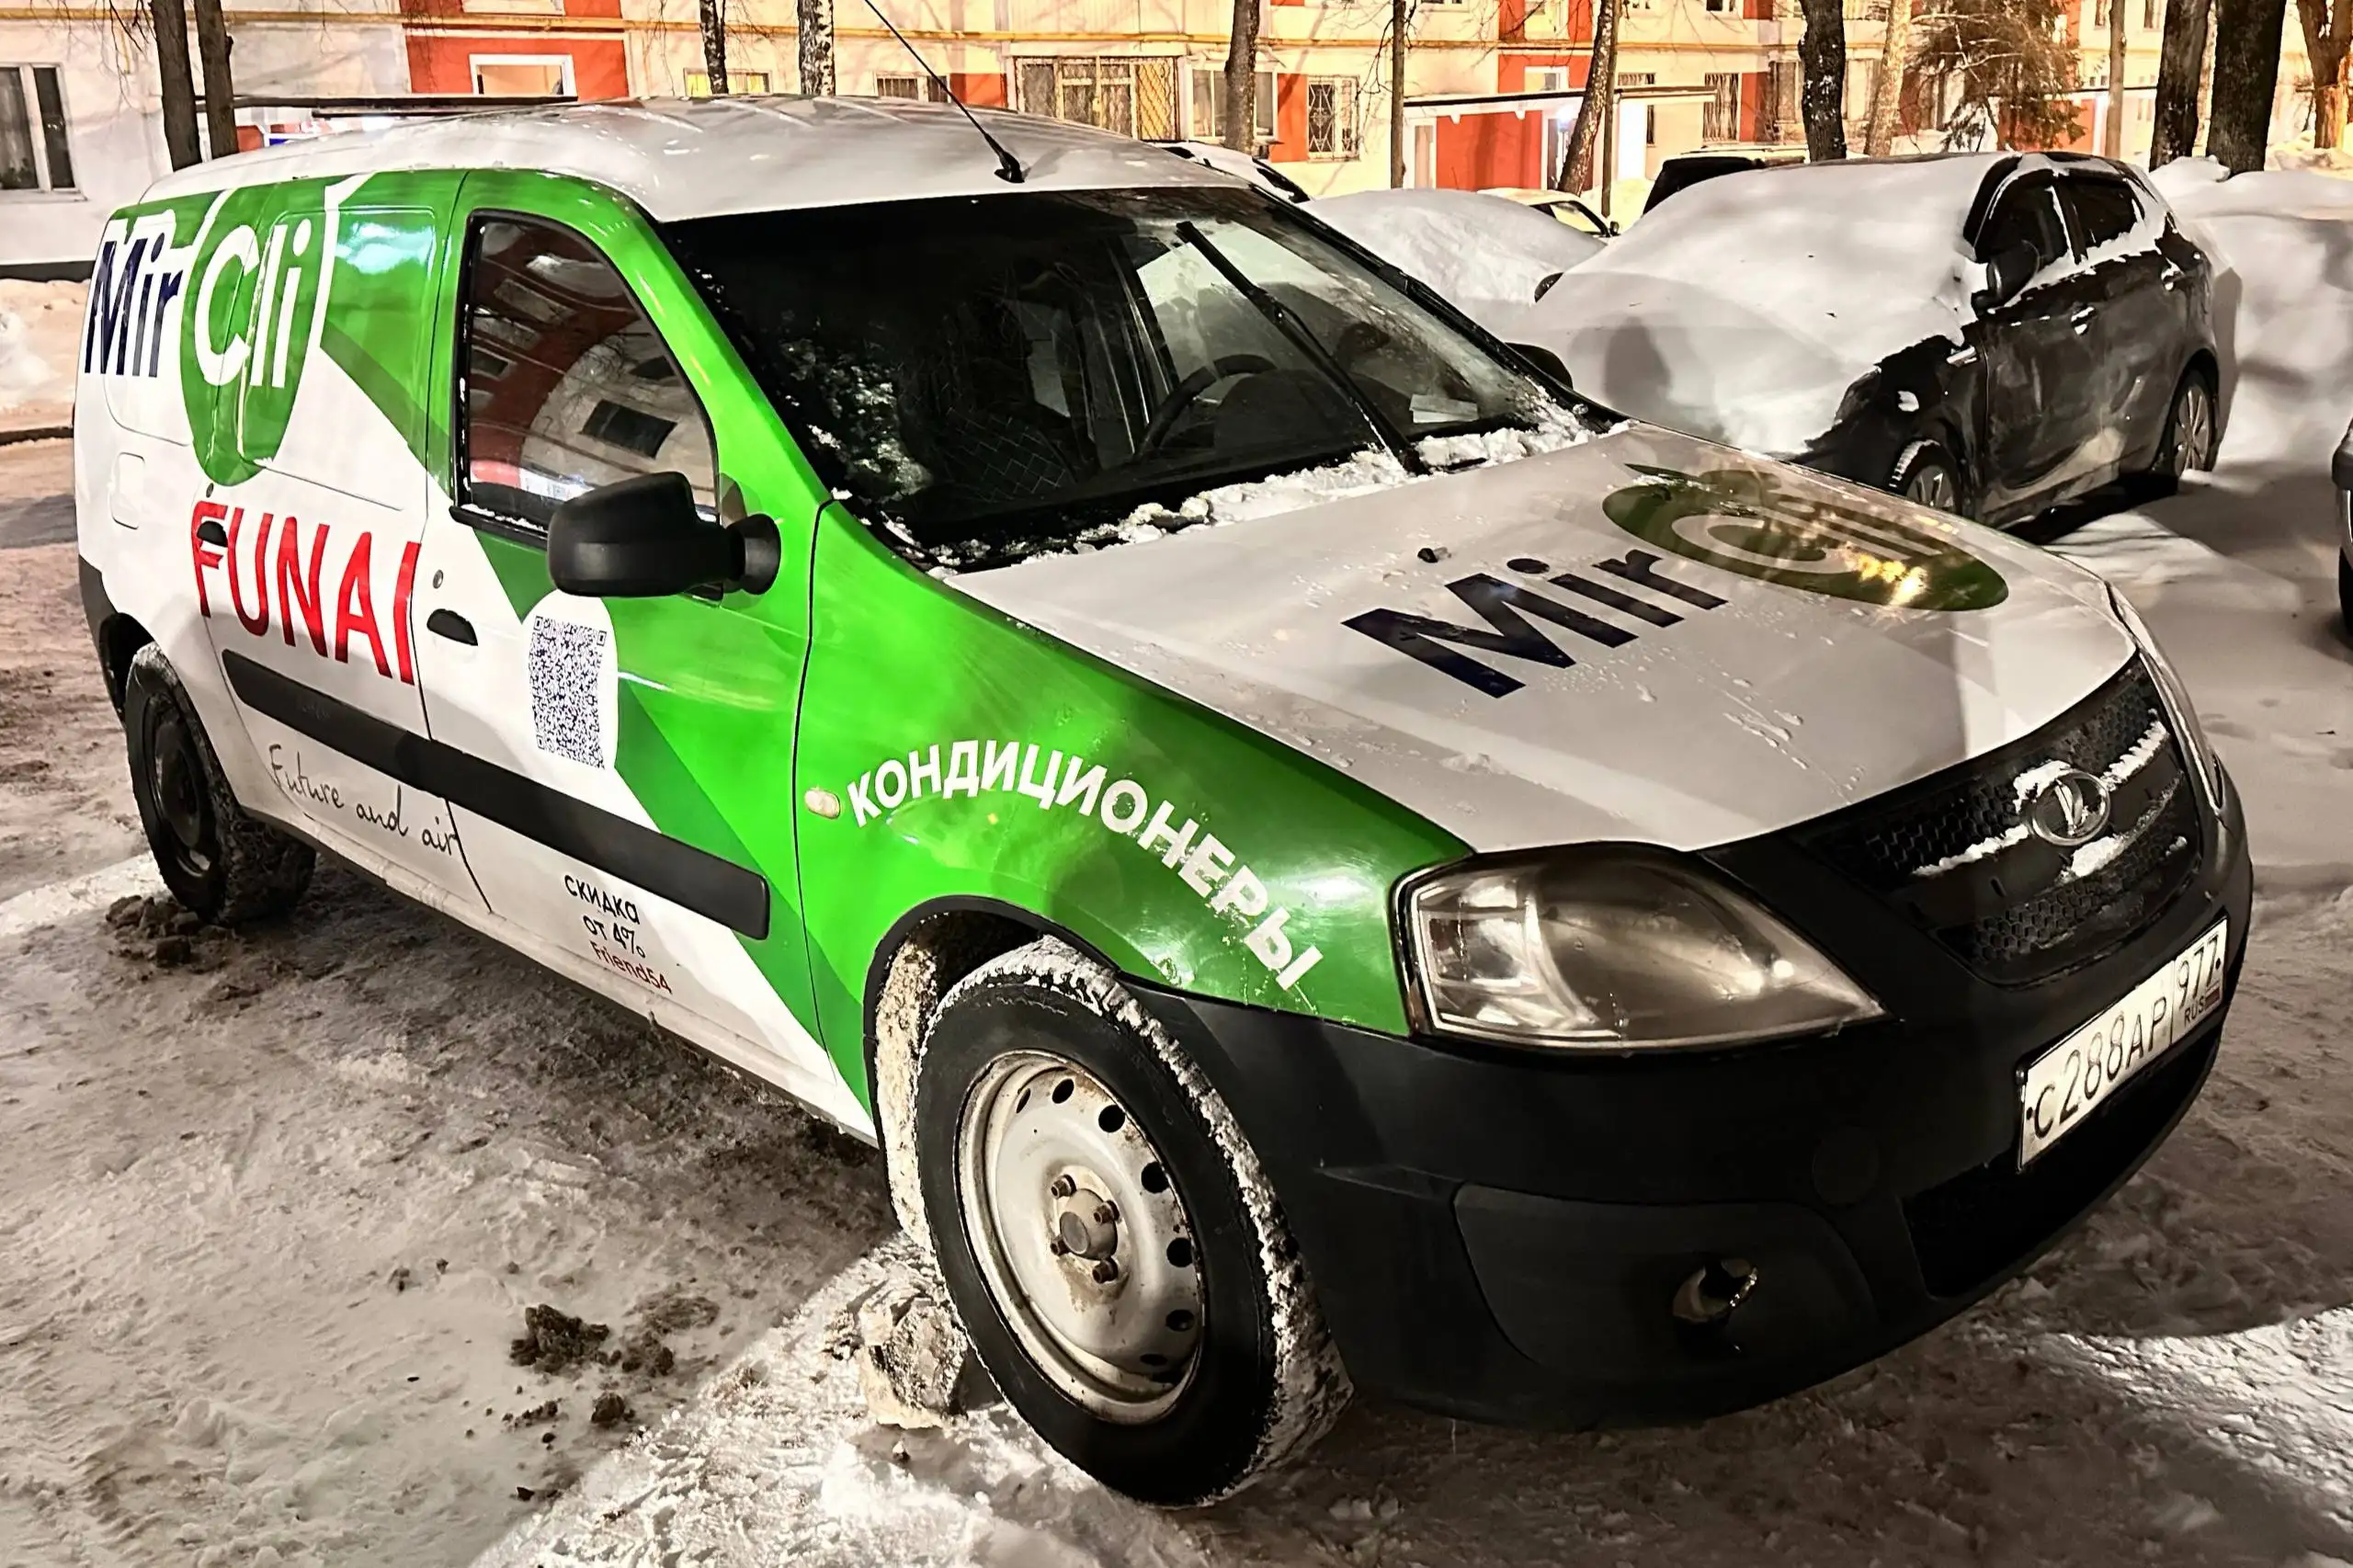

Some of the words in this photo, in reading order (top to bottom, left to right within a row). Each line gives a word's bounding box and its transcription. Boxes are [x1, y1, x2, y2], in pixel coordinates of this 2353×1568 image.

[85, 233, 184, 377] Mir
[195, 217, 312, 388] Cli
[190, 500, 422, 686] FUNAI
[1341, 548, 1729, 699] Mir
[268, 743, 345, 809] Future
[356, 784, 409, 837] and
[421, 815, 459, 856] air
[847, 739, 1324, 991] КОНДИЦИОНЕРЫ
[589, 939, 674, 995] Friend54
[612, 922, 646, 959] 4%
[2177, 931, 2219, 1012] 977
[2184, 995, 2205, 1028] RUS
